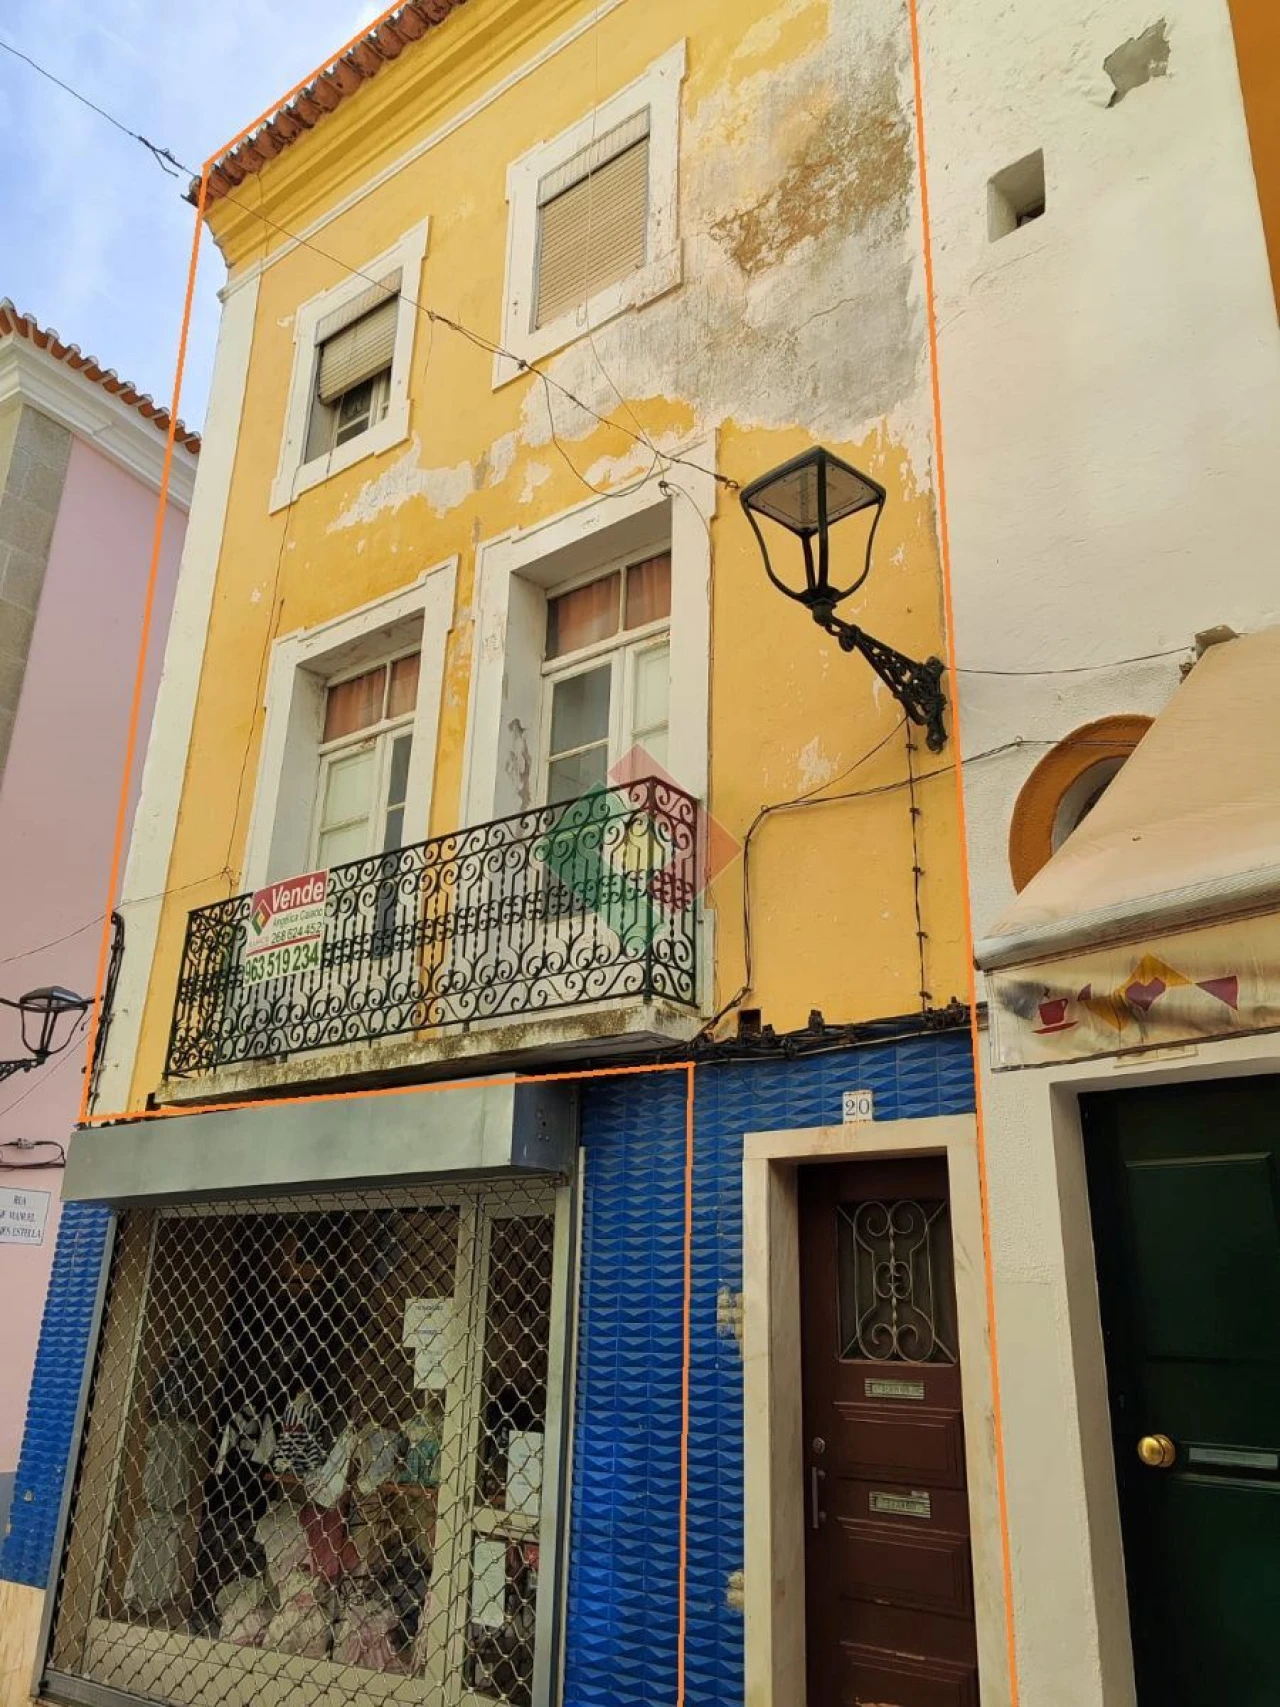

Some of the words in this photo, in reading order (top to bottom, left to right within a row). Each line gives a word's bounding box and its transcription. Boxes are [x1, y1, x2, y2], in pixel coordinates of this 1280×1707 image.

[272, 877, 324, 913] Vende
[245, 955, 264, 984] 963
[267, 947, 291, 977] 519
[293, 941, 319, 971] 234
[845, 1099, 869, 1115] 20
